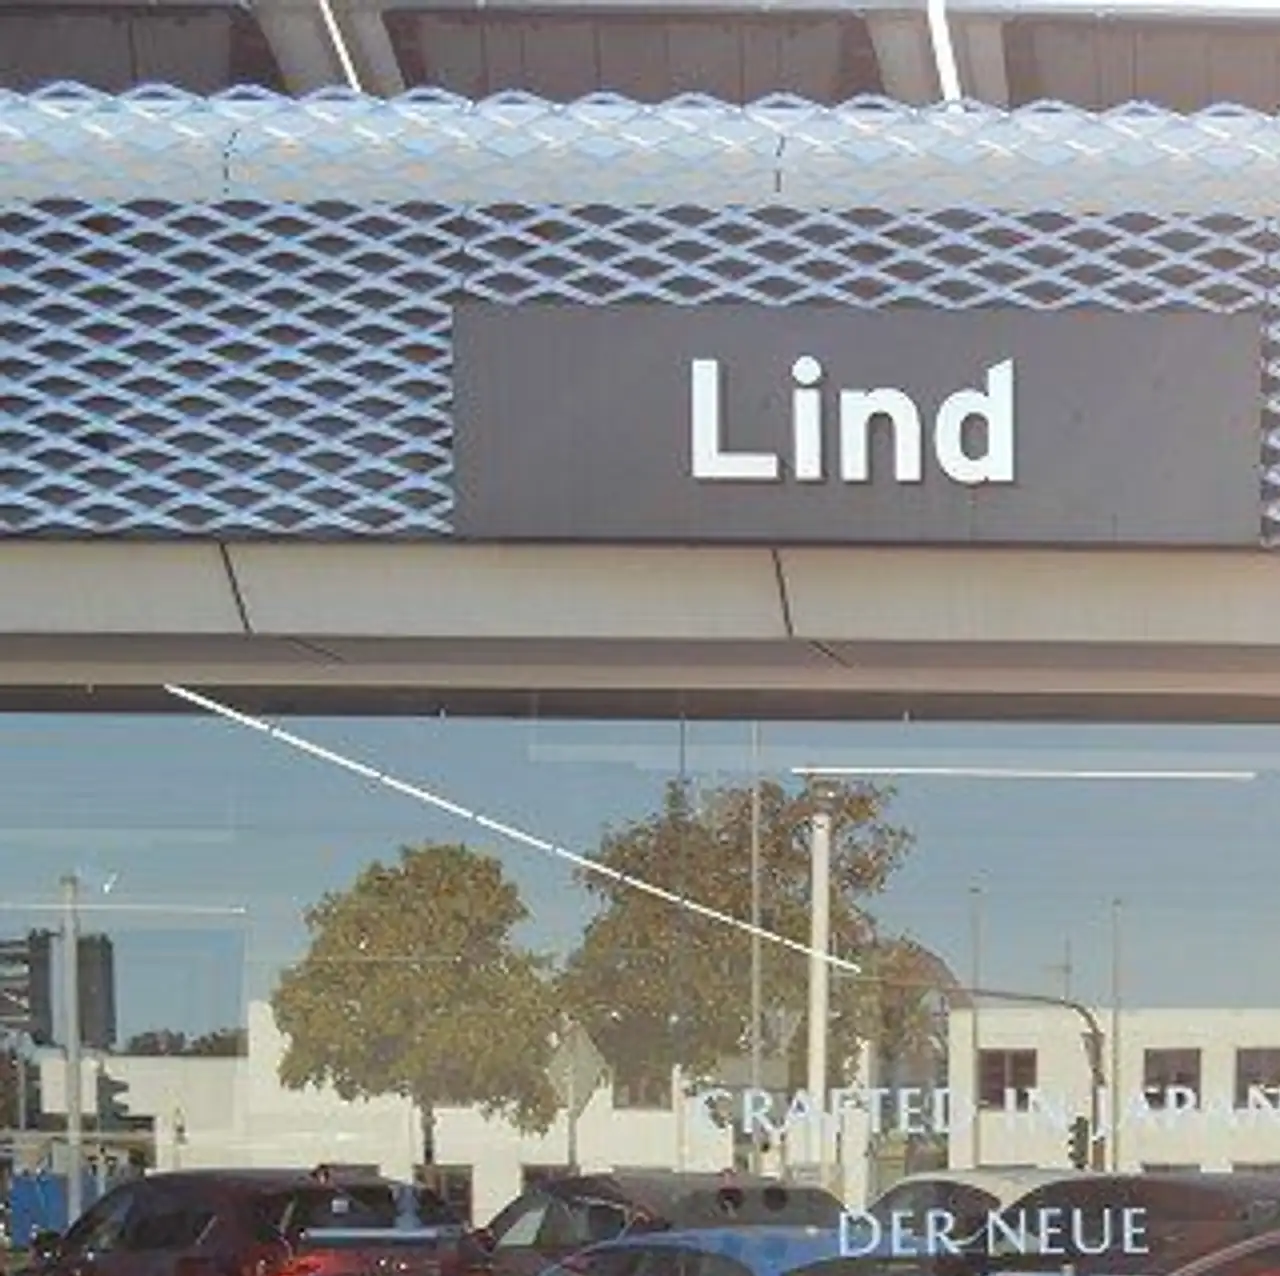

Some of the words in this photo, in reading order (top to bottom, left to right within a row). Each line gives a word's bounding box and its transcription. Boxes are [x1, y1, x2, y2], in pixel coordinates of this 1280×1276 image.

[691, 355, 1014, 484] Lind
[839, 1209, 962, 1256] DER
[988, 1208, 1149, 1255] NEUE
